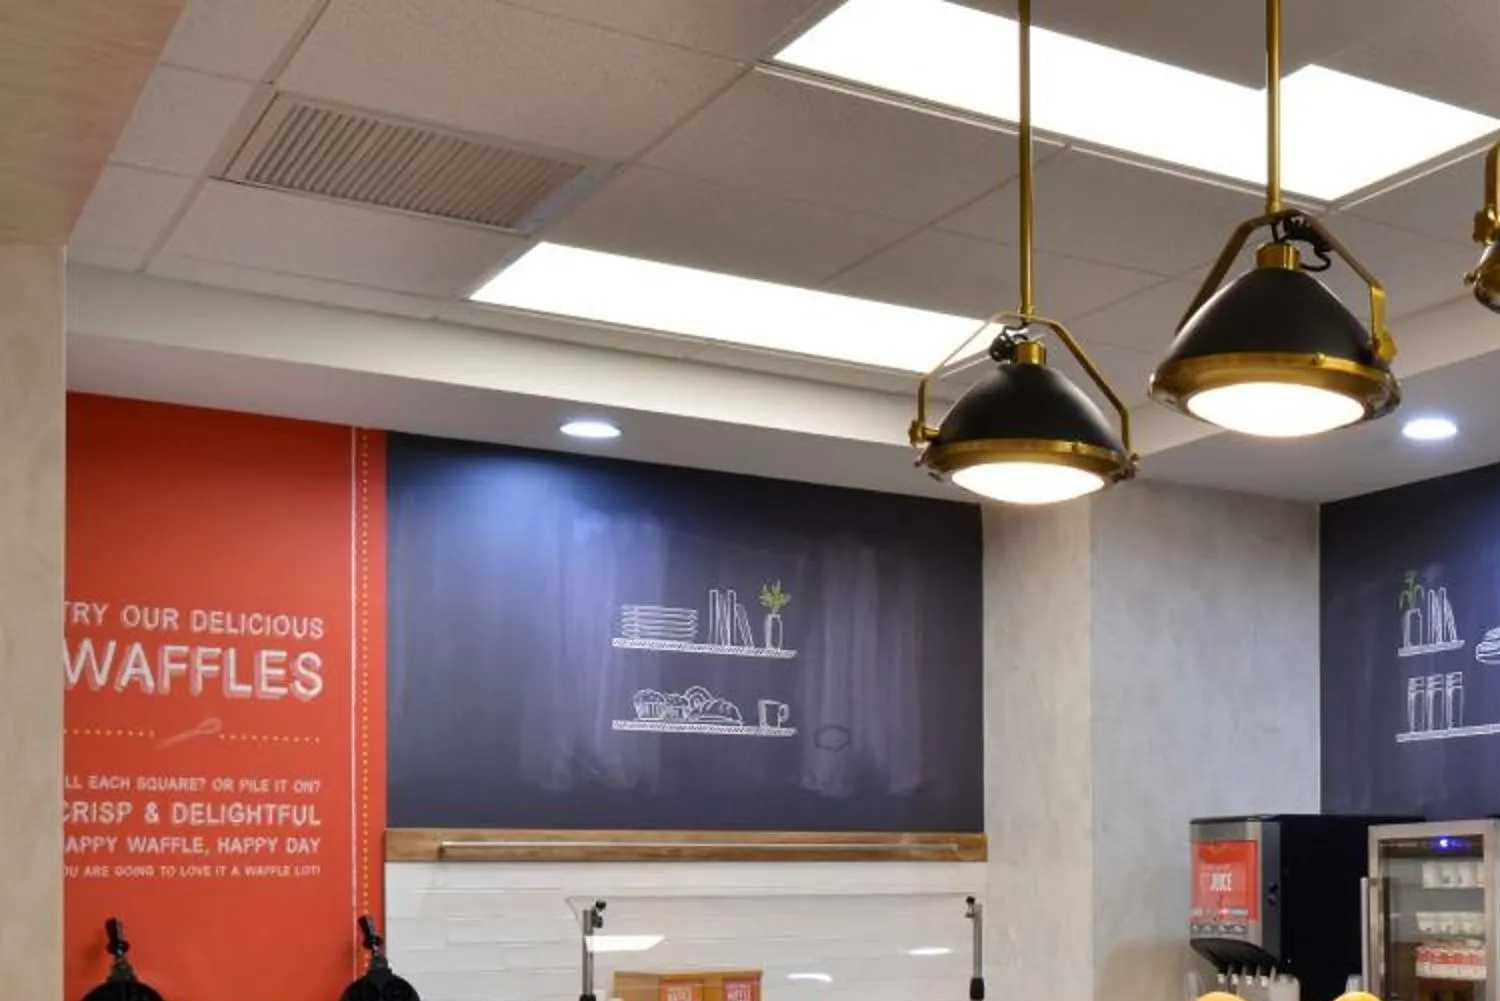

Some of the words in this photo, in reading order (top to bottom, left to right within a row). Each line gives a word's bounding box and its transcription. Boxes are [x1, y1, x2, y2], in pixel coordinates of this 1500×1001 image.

[122, 604, 179, 631] OUR
[190, 609, 324, 639] DELICIOUS
[63, 637, 323, 701] WAFFLES
[87, 775, 131, 790] EACH
[136, 776, 205, 792] SQUARE?
[211, 777, 234, 792] OR
[239, 778, 269, 793] PILE
[274, 779, 288, 793] IT
[144, 801, 160, 824] &
[170, 801, 320, 826] DELIGHTFUL
[66, 836, 119, 854] APPY
[126, 836, 209, 856] WAFFLE,
[217, 836, 278, 854] HAPPY
[286, 837, 320, 854] DAY
[84, 865, 110, 878] ARE
[114, 866, 155, 878] GOING
[160, 866, 176, 878] TO
[179, 866, 211, 878] LOVE
[215, 866, 227, 877] IT
[230, 866, 240, 877] A
